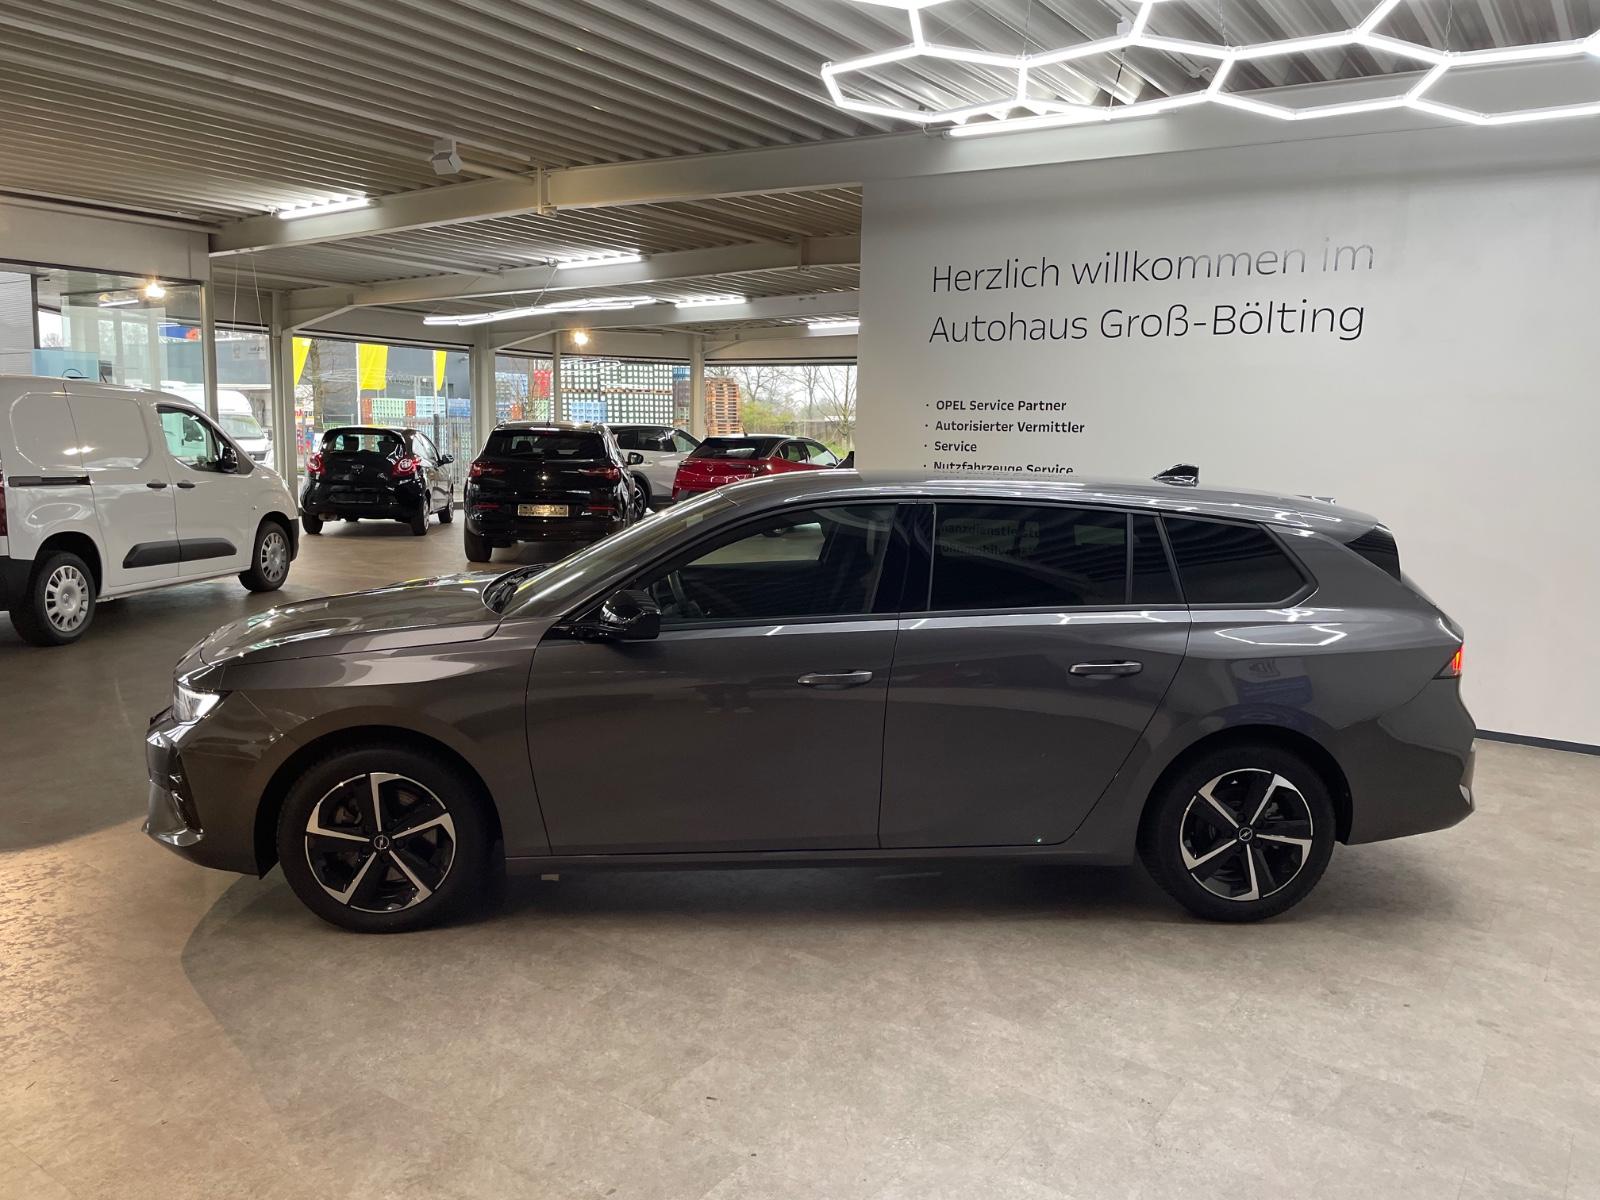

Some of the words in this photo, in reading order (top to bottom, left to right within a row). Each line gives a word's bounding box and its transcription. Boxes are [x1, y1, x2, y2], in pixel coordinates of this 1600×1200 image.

[932, 257, 1060, 293] Herzlich
[1071, 250, 1306, 286] willkommen
[1322, 236, 1375, 273] im
[929, 311, 1089, 344] Autohaus
[1100, 298, 1366, 341] Groß-Bölting
[935, 400, 967, 411] OPEL
[969, 399, 1015, 411] Service
[1017, 400, 1067, 412] Partner
[935, 419, 1014, 432] Autorisierter
[1017, 420, 1086, 434] Vermittler
[934, 440, 978, 452] Service
